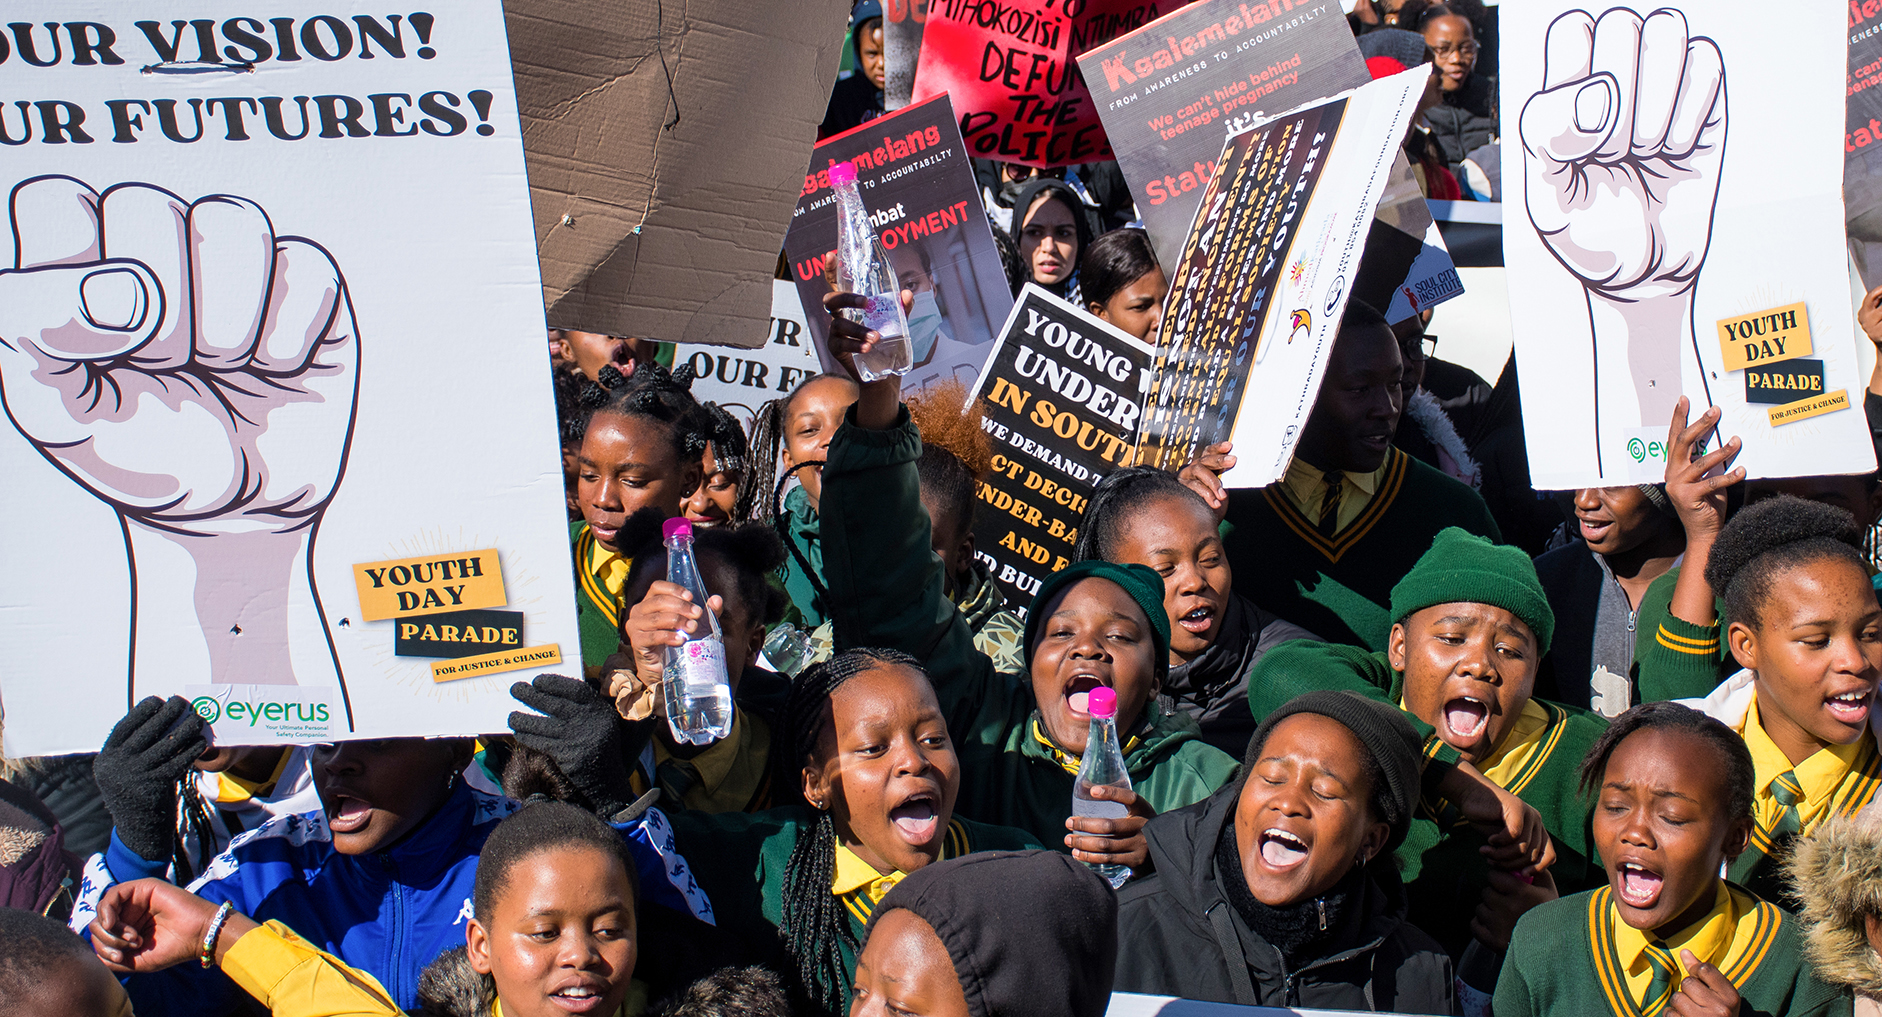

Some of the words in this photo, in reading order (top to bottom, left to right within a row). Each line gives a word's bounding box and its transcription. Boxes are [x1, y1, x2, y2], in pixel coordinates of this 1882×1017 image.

[0, 22, 126, 66] UR
[134, 12, 438, 65] VISION!
[1109, 93, 1138, 110] FROM
[1214, 51, 1228, 63] TO
[1236, 5, 1327, 53] ACCOUNTABILTY
[1008, 95, 1083, 126] THE
[1148, 116, 1174, 131] We
[1176, 94, 1213, 120] can't
[1214, 81, 1247, 108] hide
[1249, 53, 1302, 85] behind
[1160, 108, 1220, 141] teenage
[1222, 70, 1299, 115] pregnancy
[105, 89, 496, 143] FUTURES!
[863, 181, 876, 190] TO
[881, 148, 952, 184] ACCOUNTABILTY
[1145, 156, 1221, 206] Stat
[1197, 347, 1222, 420] BUILD
[1219, 324, 1229, 342] A
[1226, 242, 1257, 320] SAFER
[1255, 189, 1277, 237] AND
[1274, 117, 1304, 186] MORE
[1203, 323, 1220, 372] AND
[1217, 123, 1292, 320] DISCRIMINATION
[1234, 284, 1266, 366] OUR
[1262, 129, 1326, 278] YOUTH!
[1167, 373, 1190, 446] DEMAND
[1187, 322, 1203, 370] THAT
[1200, 205, 1242, 319] GOVERNMENT
[1239, 179, 1252, 204] DO
[1249, 129, 1270, 177] MORE
[1210, 308, 1245, 407] EQUAL
[1241, 181, 1291, 303] SOCIETY
[1415, 276, 1438, 293] SOUL
[1438, 267, 1457, 285] CITY
[1420, 278, 1463, 303] INSTITUTE
[1153, 373, 1173, 426] IS
[1167, 264, 1204, 367] NOT
[1197, 188, 1227, 255] AN
[1168, 424, 1185, 466] TO
[1181, 358, 1202, 417] END
[1199, 294, 1220, 350] ALL
[1217, 185, 1259, 290] FORMS
[1256, 144, 1274, 181] OF
[1724, 310, 1797, 342] YOUTH
[770, 316, 801, 347] R
[1024, 308, 1132, 382] YOUNG
[1744, 336, 1787, 361] DAY
[688, 351, 769, 389] OUR
[1014, 345, 1140, 431] UNDER
[1748, 372, 1821, 390] PARADE
[987, 376, 1032, 415] IN
[1771, 410, 1784, 421] FOR
[1785, 405, 1812, 417] JUSTICE
[1818, 396, 1845, 410] CHANGE
[980, 415, 1007, 441] WE
[1010, 428, 1089, 481] DEMAND
[990, 454, 1024, 480] CT
[975, 481, 1078, 546] NDER-BA
[999, 531, 1050, 564] AND
[364, 557, 484, 588] YOUTH
[396, 585, 466, 611] DAY
[400, 623, 518, 645] PARADE
[435, 665, 457, 676] FOR
[458, 658, 503, 673] JUSTICE
[504, 656, 511, 665] &
[513, 650, 556, 664] CHANGE
[226, 701, 329, 727] eyerus
